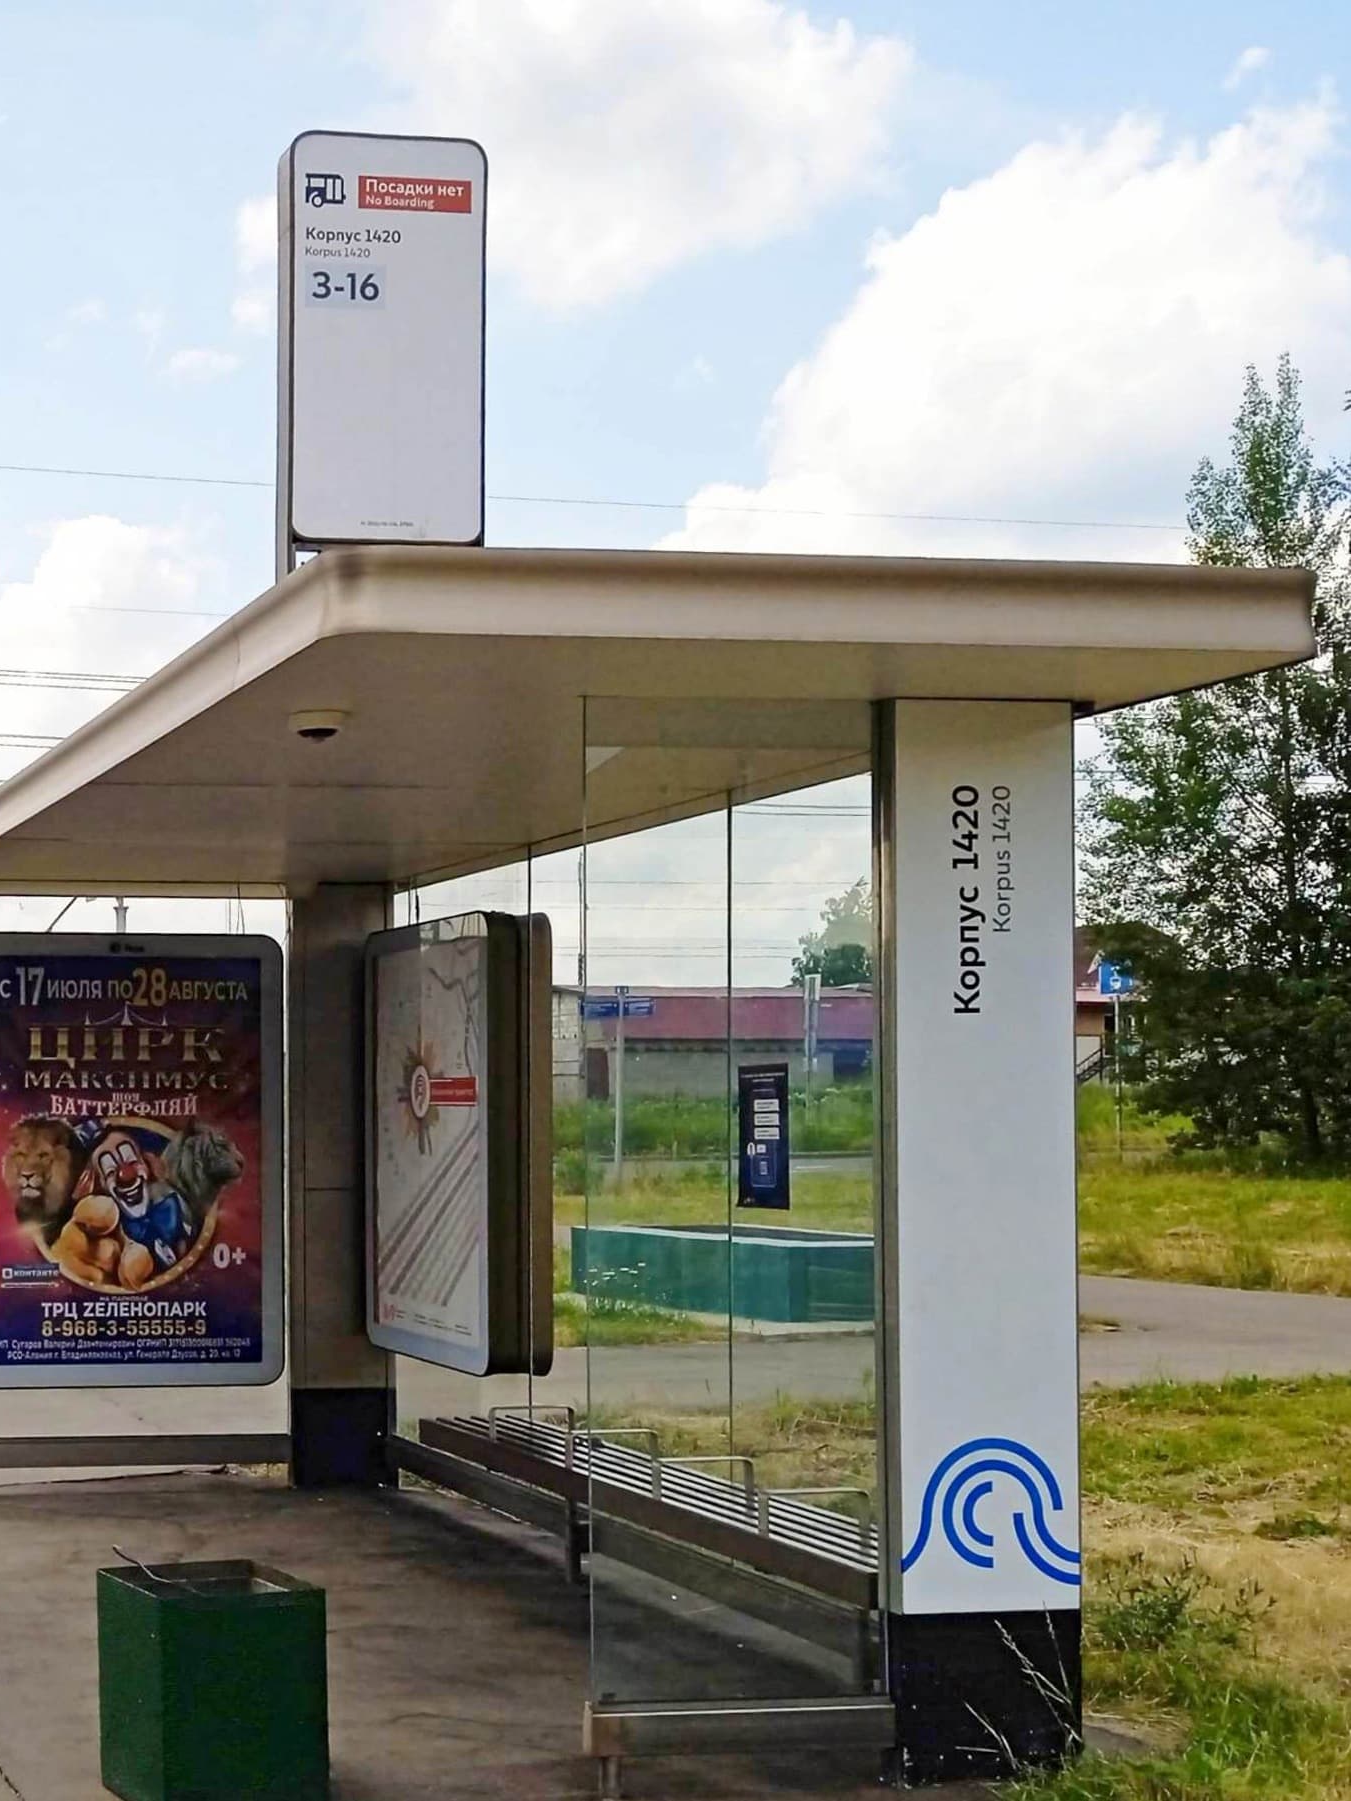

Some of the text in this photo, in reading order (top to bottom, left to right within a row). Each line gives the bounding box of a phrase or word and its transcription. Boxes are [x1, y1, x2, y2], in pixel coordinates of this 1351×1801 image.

[365, 179, 465, 197] Посадки нет
[365, 195, 435, 210] No Boarding
[305, 227, 402, 245] Корпус 1420
[305, 246, 371, 259] Korpus 1420
[992, 785, 1015, 933] Korpus 1420
[951, 784, 986, 1014] Корпус 1420
[15, 967, 45, 1006] 17
[47, 979, 102, 999] ИЮЛЯ
[107, 979, 133, 999] ПО
[132, 967, 168, 1007] 28
[169, 981, 248, 1001] АВГУСТА
[28, 1026, 226, 1069] ЦИРК
[24, 1069, 228, 1090] МАКСИМУС
[50, 1093, 198, 1116] БАТТЕРФЛЯЙ
[212, 1243, 247, 1270] 0+
[41, 1302, 78, 1320] ТРЦ
[41, 1319, 207, 1337] 8-968-3-55555-9
